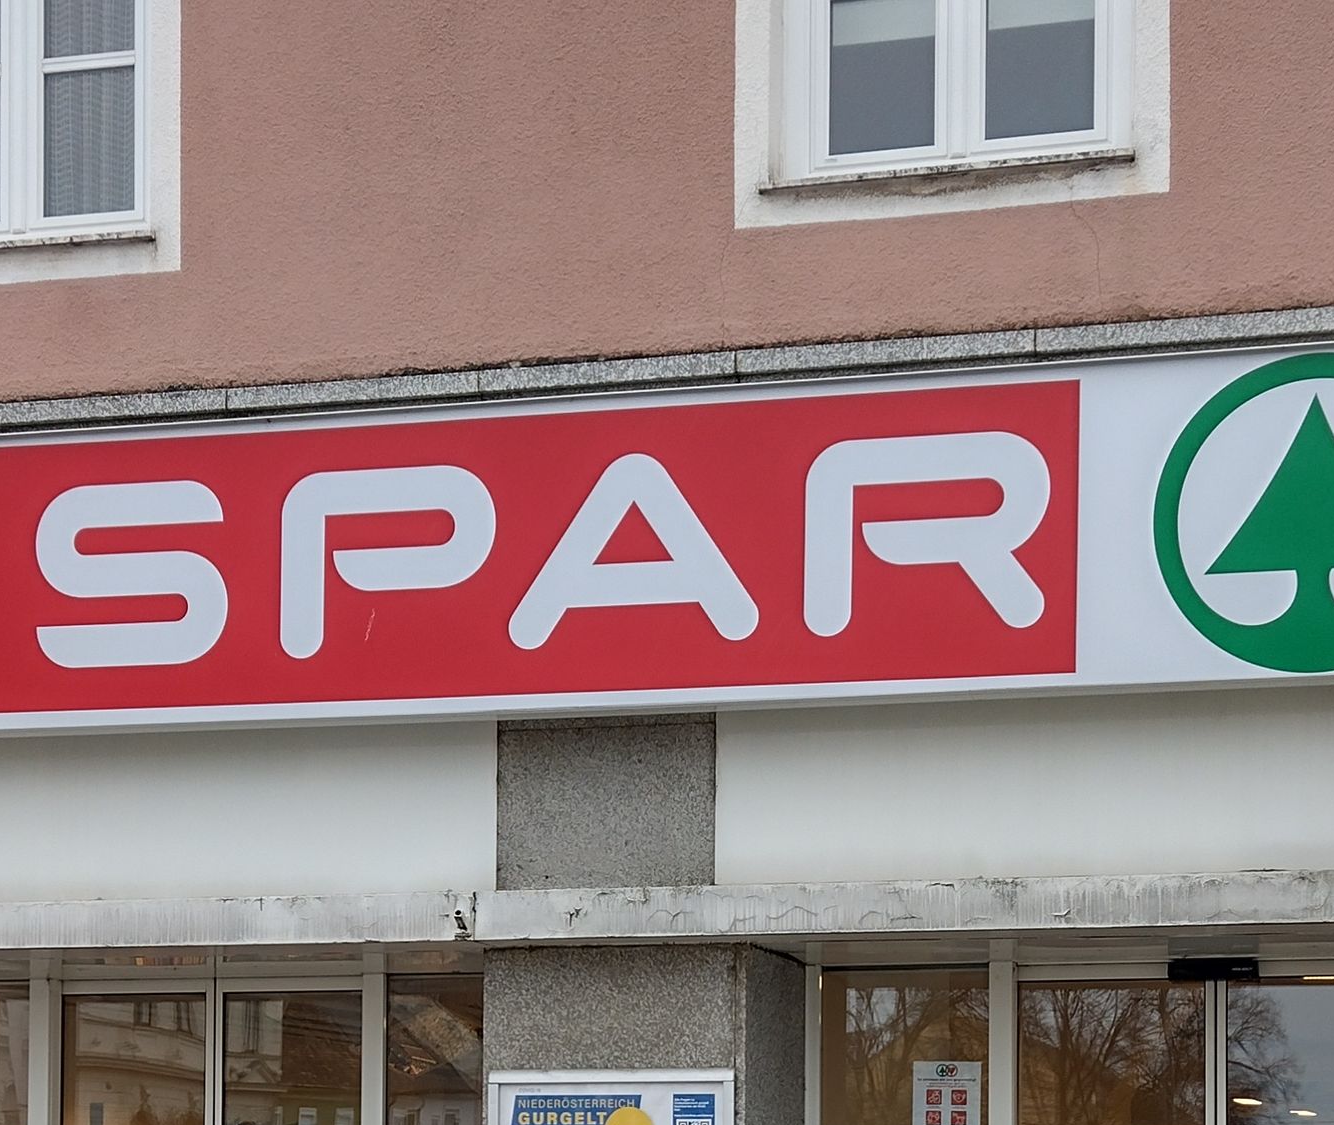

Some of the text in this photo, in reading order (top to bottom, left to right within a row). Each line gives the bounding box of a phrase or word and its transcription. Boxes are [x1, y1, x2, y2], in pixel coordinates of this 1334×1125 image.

[35, 430, 1050, 671] SPAR
[517, 1097, 635, 1110] NIEDERÖSTERREICH
[518, 1112, 607, 1125] GURGELT
